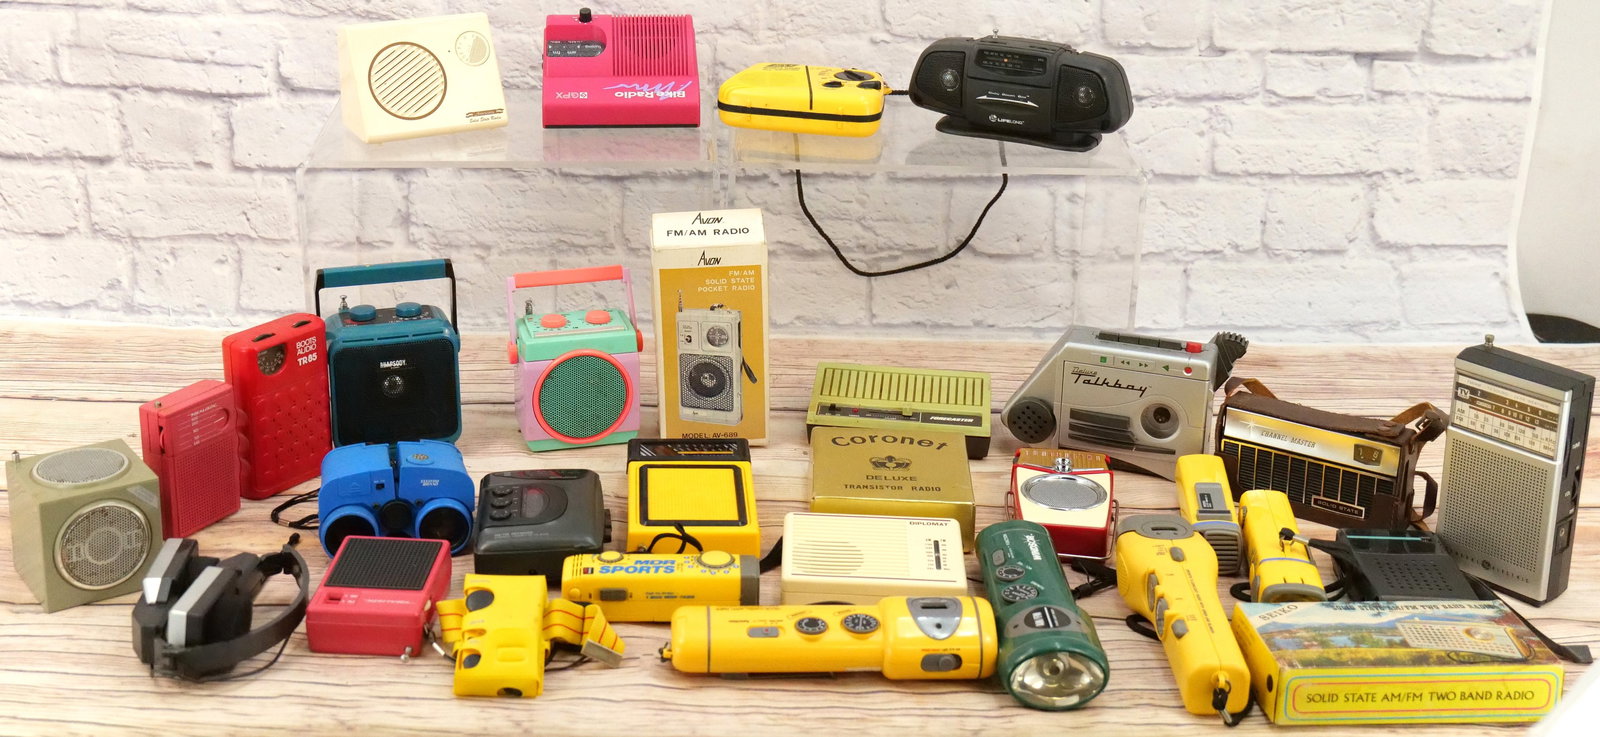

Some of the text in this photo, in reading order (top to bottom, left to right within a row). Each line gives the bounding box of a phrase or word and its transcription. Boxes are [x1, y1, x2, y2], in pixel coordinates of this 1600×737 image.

[614, 90, 686, 98] Bike Radio
[666, 227, 750, 238] FM/AM RADIO
[296, 336, 317, 350] BOOTS
[296, 344, 317, 356] AUDIO
[1260, 430, 1316, 448] CHANNEL MASTER
[1317, 500, 1359, 514] SOLID STATE
[599, 566, 676, 574] SPORTS
[1258, 604, 1298, 620] SEIKO
[1306, 690, 1534, 704] SOLID STATE AM/FM TWO BAND RADIO
